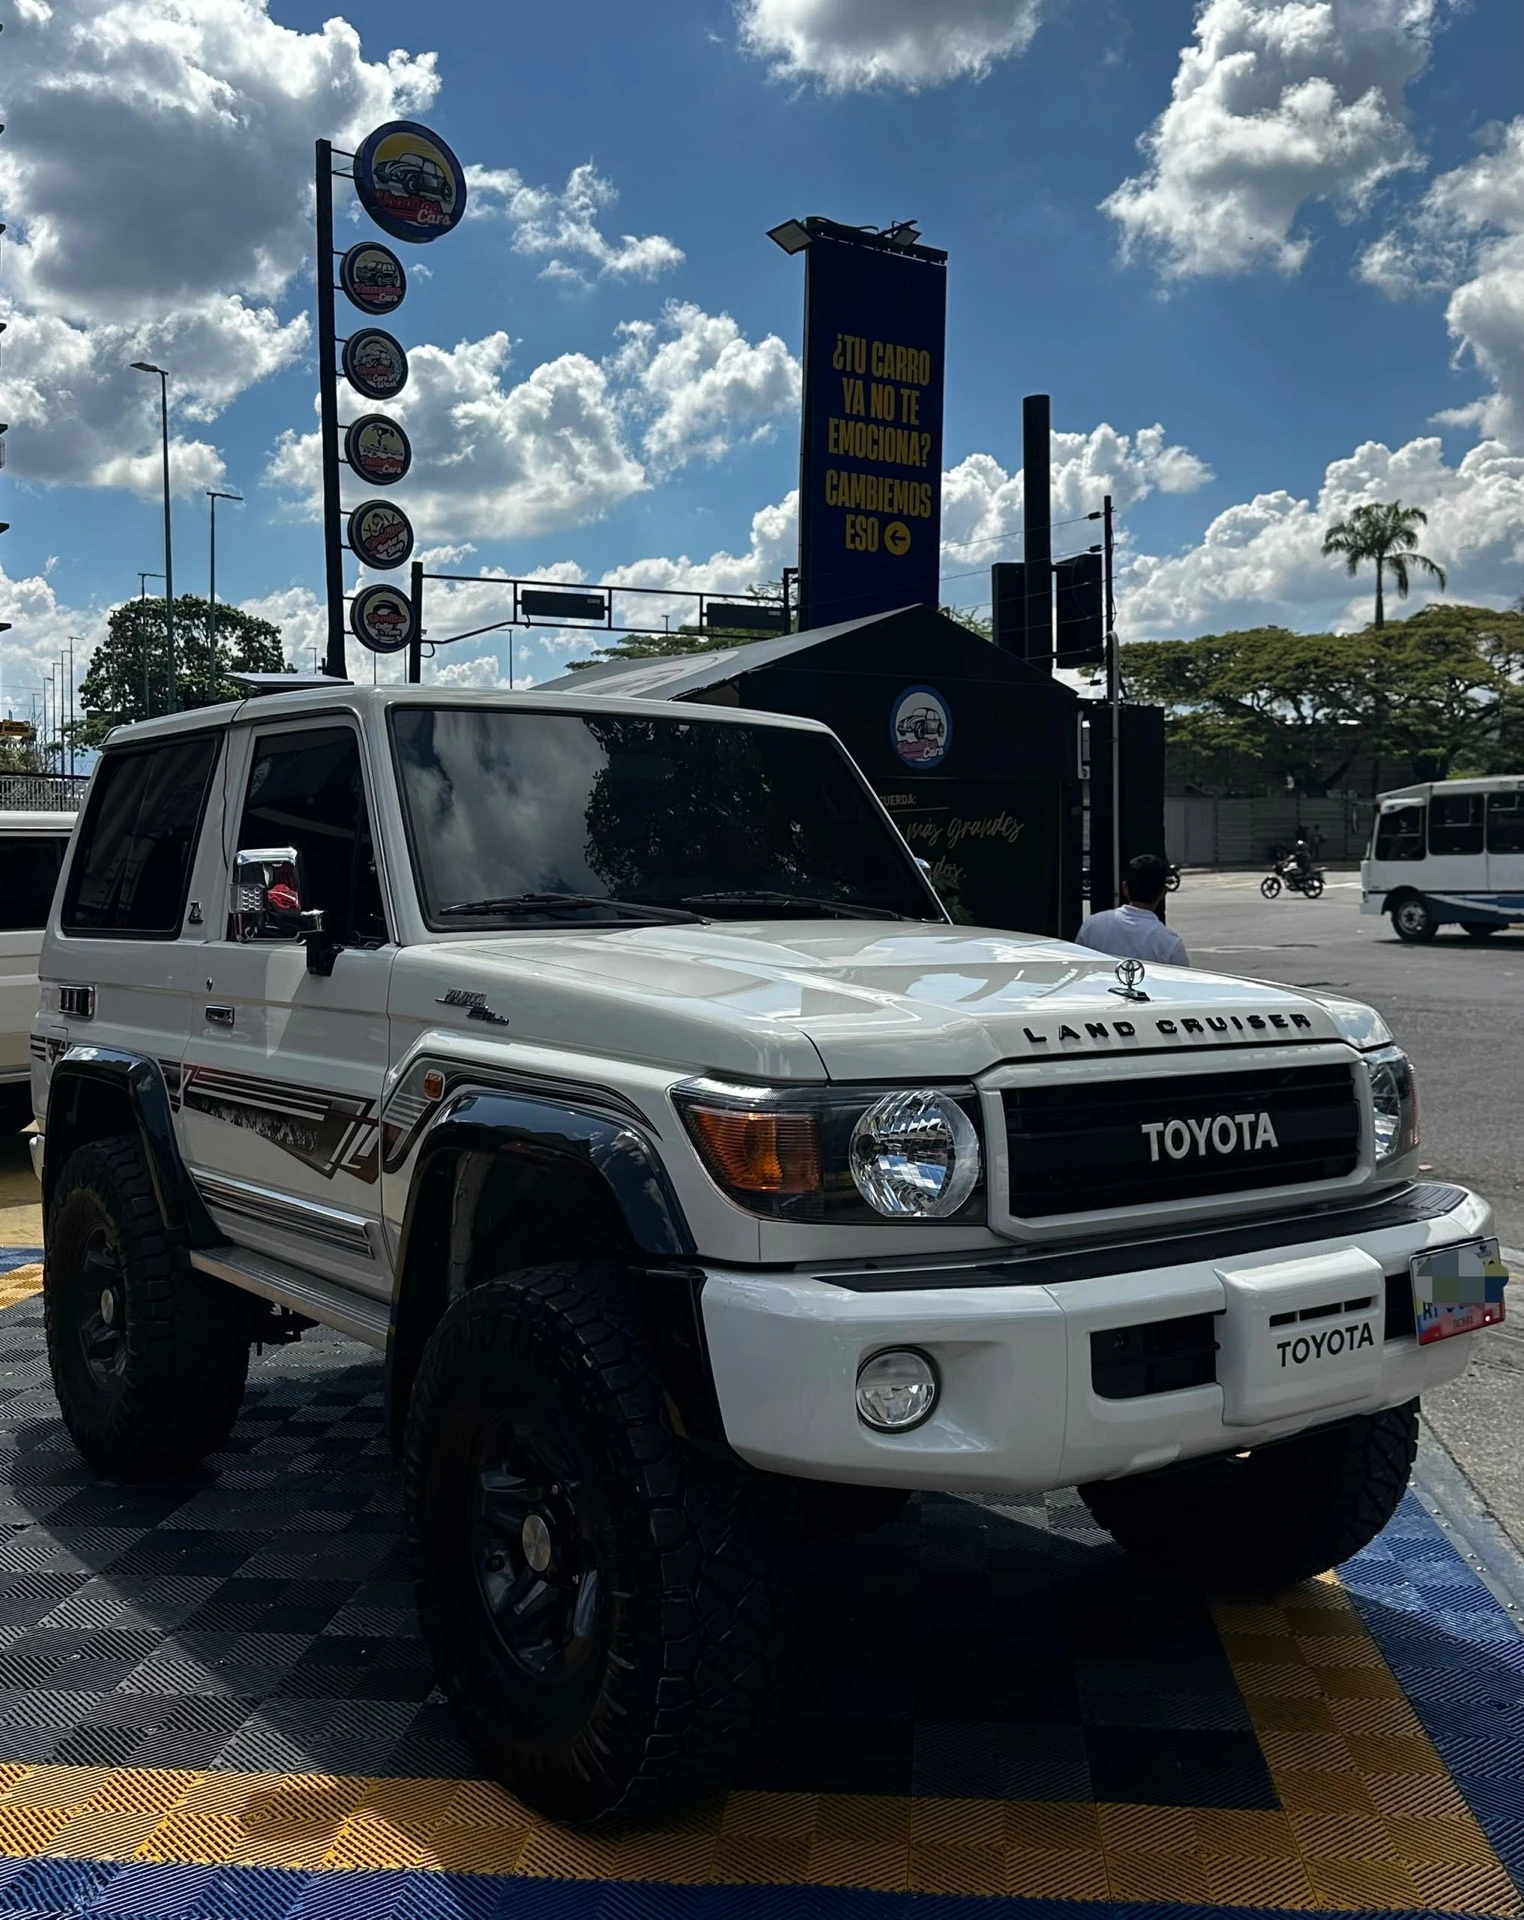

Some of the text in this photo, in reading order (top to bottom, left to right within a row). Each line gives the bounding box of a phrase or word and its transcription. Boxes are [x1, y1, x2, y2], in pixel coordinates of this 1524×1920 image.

[416, 208, 451, 226] Cars
[832, 332, 931, 386] ¿TU CARRO
[842, 376, 920, 426] YA NO TE
[828, 416, 931, 468] EMOCIONA?
[825, 468, 932, 519] CAMBIEMOS
[845, 514, 879, 553] ESO
[923, 747, 944, 758] Cars
[947, 810, 1026, 849] grandes
[1022, 1013, 1312, 1043] LAND CRUISER
[1140, 1111, 1279, 1162] TOYOTA
[1276, 1321, 1375, 1368] TOYOTA
